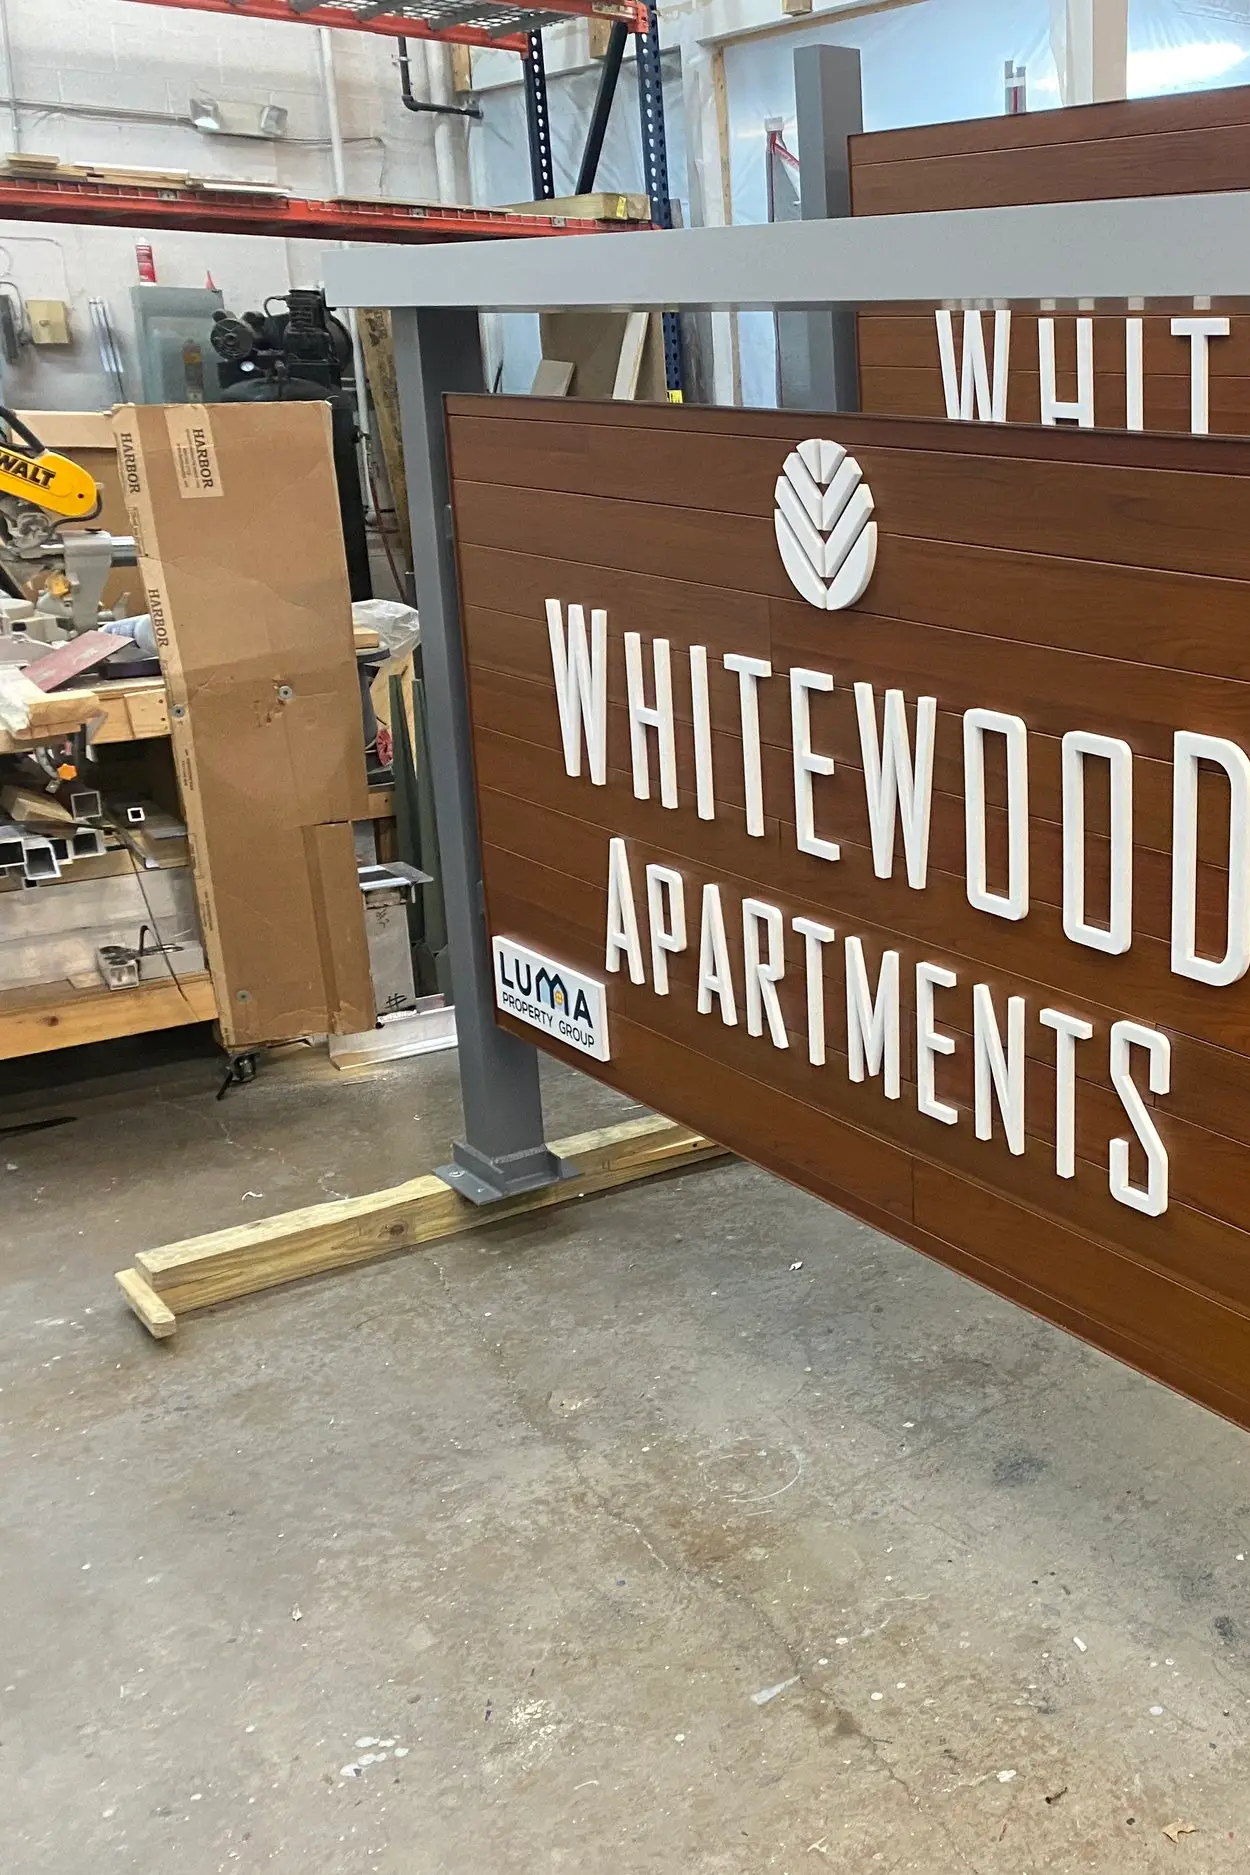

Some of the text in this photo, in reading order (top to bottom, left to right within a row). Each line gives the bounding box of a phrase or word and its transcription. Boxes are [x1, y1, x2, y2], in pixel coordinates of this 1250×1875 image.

[120, 432, 141, 494] HARBOR
[193, 428, 214, 489] HARBOR
[148, 588, 169, 648] HARBOR
[499, 951, 594, 1029] LUMA
[502, 991, 595, 1048] PROPERTY GROUP
[605, 837, 1171, 1218] APARTMENTS
